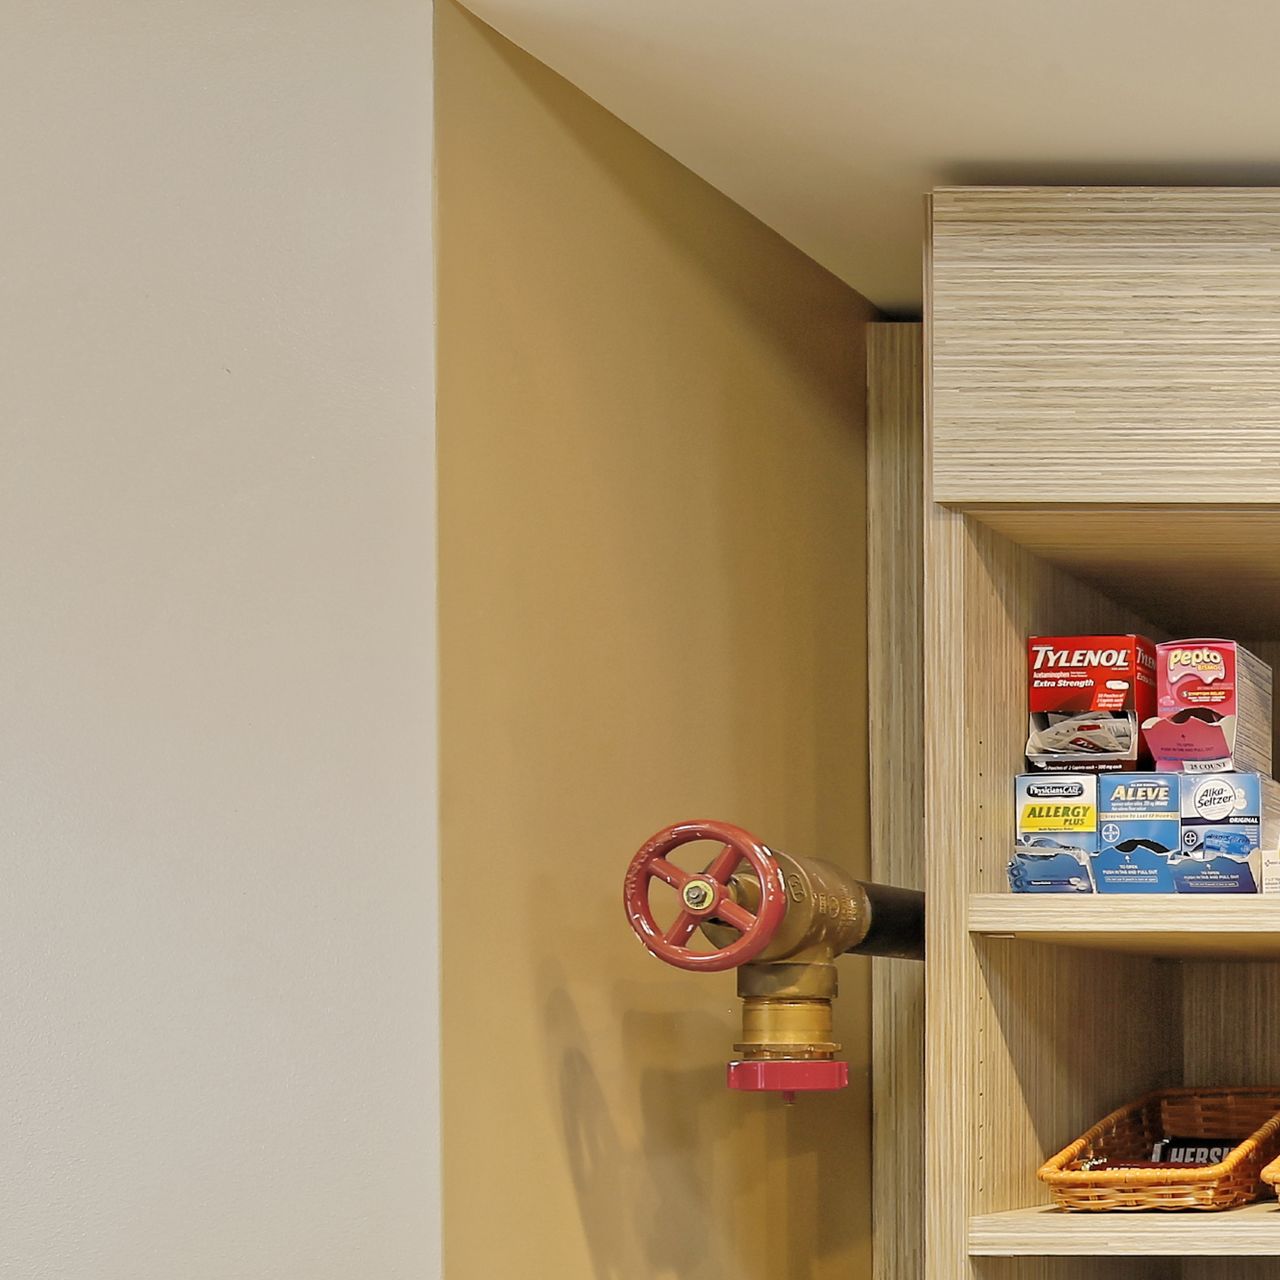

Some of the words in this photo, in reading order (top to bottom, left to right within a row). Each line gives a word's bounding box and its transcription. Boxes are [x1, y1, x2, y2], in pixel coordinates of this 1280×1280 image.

[1032, 647, 1130, 670] TYLENOL
[1169, 648, 1221, 671] Pepto
[1033, 680, 1056, 688] Extra
[1057, 680, 1095, 688] Strength
[1110, 785, 1170, 801] ALEVE
[1202, 787, 1228, 797] Alka-
[1198, 794, 1234, 808] Seltzer
[1027, 806, 1091, 818] ALLERGY
[1063, 818, 1085, 826] PLUS
